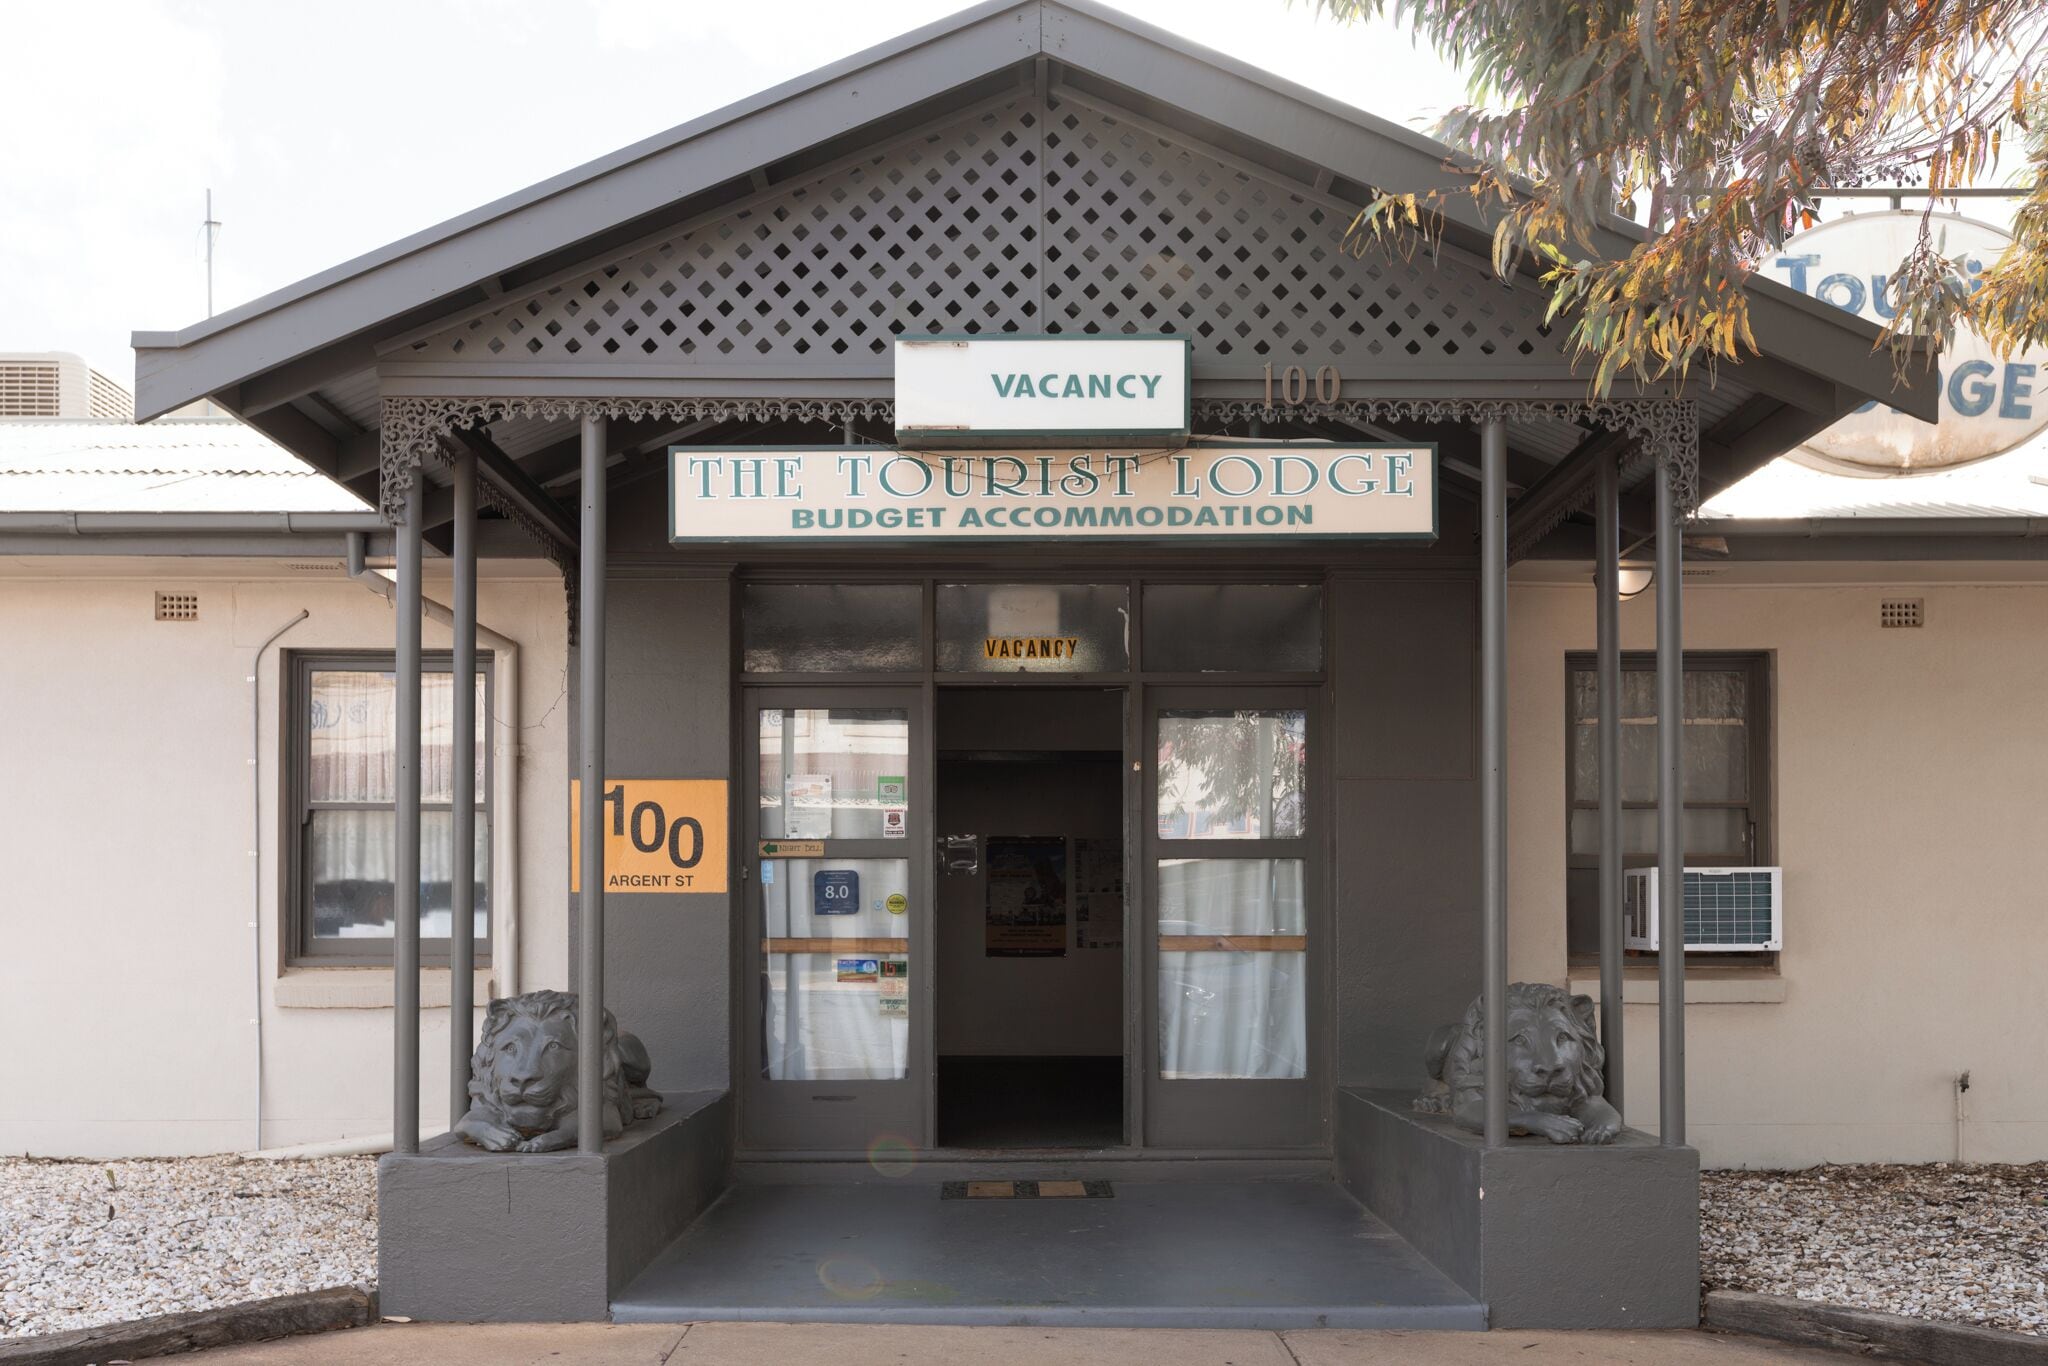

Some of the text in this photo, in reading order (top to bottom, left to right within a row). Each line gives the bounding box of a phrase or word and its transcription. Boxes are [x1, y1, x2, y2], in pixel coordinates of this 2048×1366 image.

[990, 373, 1160, 400] VACANCY
[1263, 361, 1341, 410] 100
[688, 452, 1415, 500] THE TOURIST LODGE
[791, 505, 1314, 529] BUDGET ACCOMMODATION
[986, 639, 1077, 657] VACANCY
[604, 785, 704, 868] 100
[609, 875, 694, 887] ARGENT ST
[825, 885, 849, 899] 8.0
